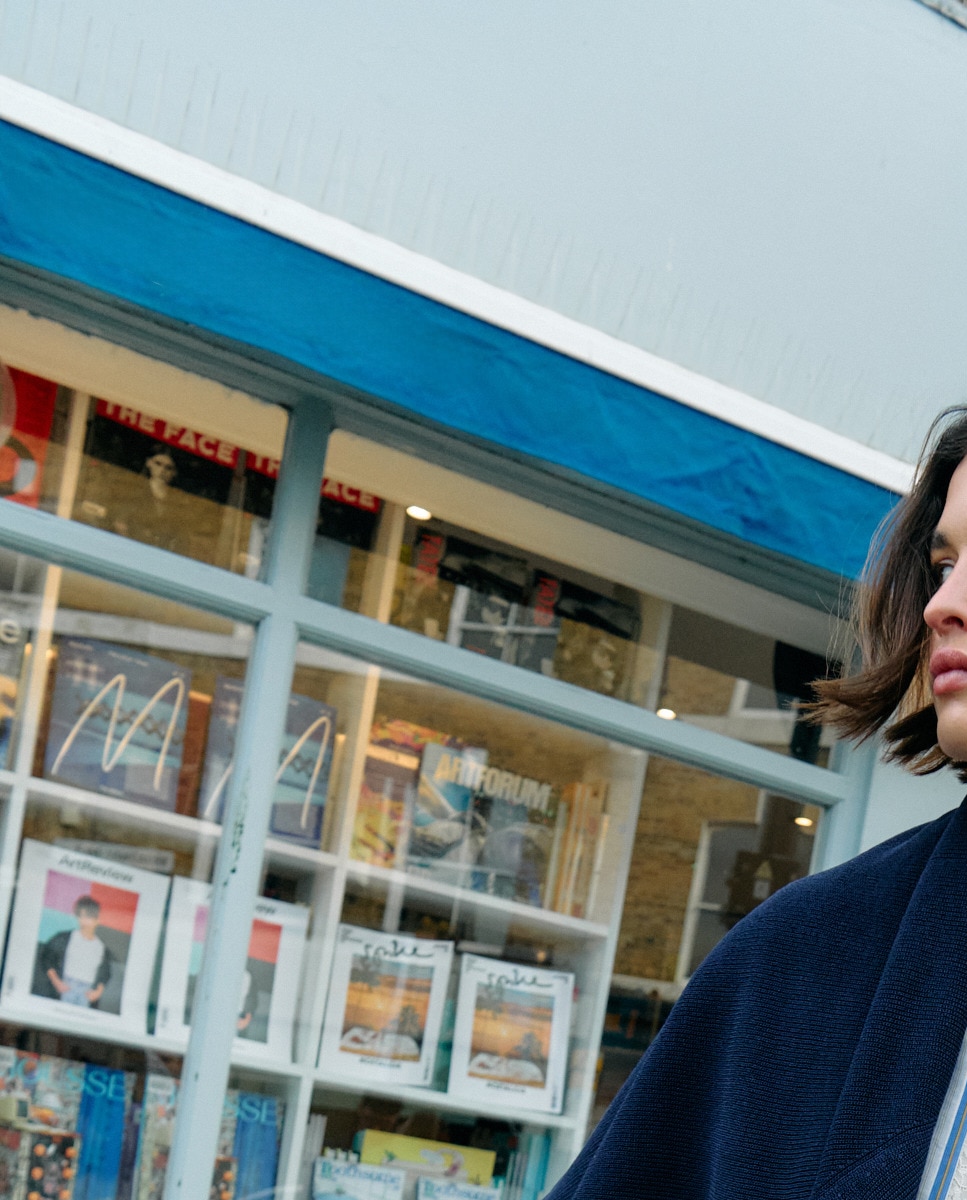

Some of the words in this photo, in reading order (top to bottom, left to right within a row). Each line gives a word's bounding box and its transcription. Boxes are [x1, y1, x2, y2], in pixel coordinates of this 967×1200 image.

[103, 400, 155, 433] THE
[163, 421, 235, 464] FACE
[254, 454, 280, 475] TH
[322, 479, 375, 508] ACE
[434, 753, 553, 812] ARTFORUM
